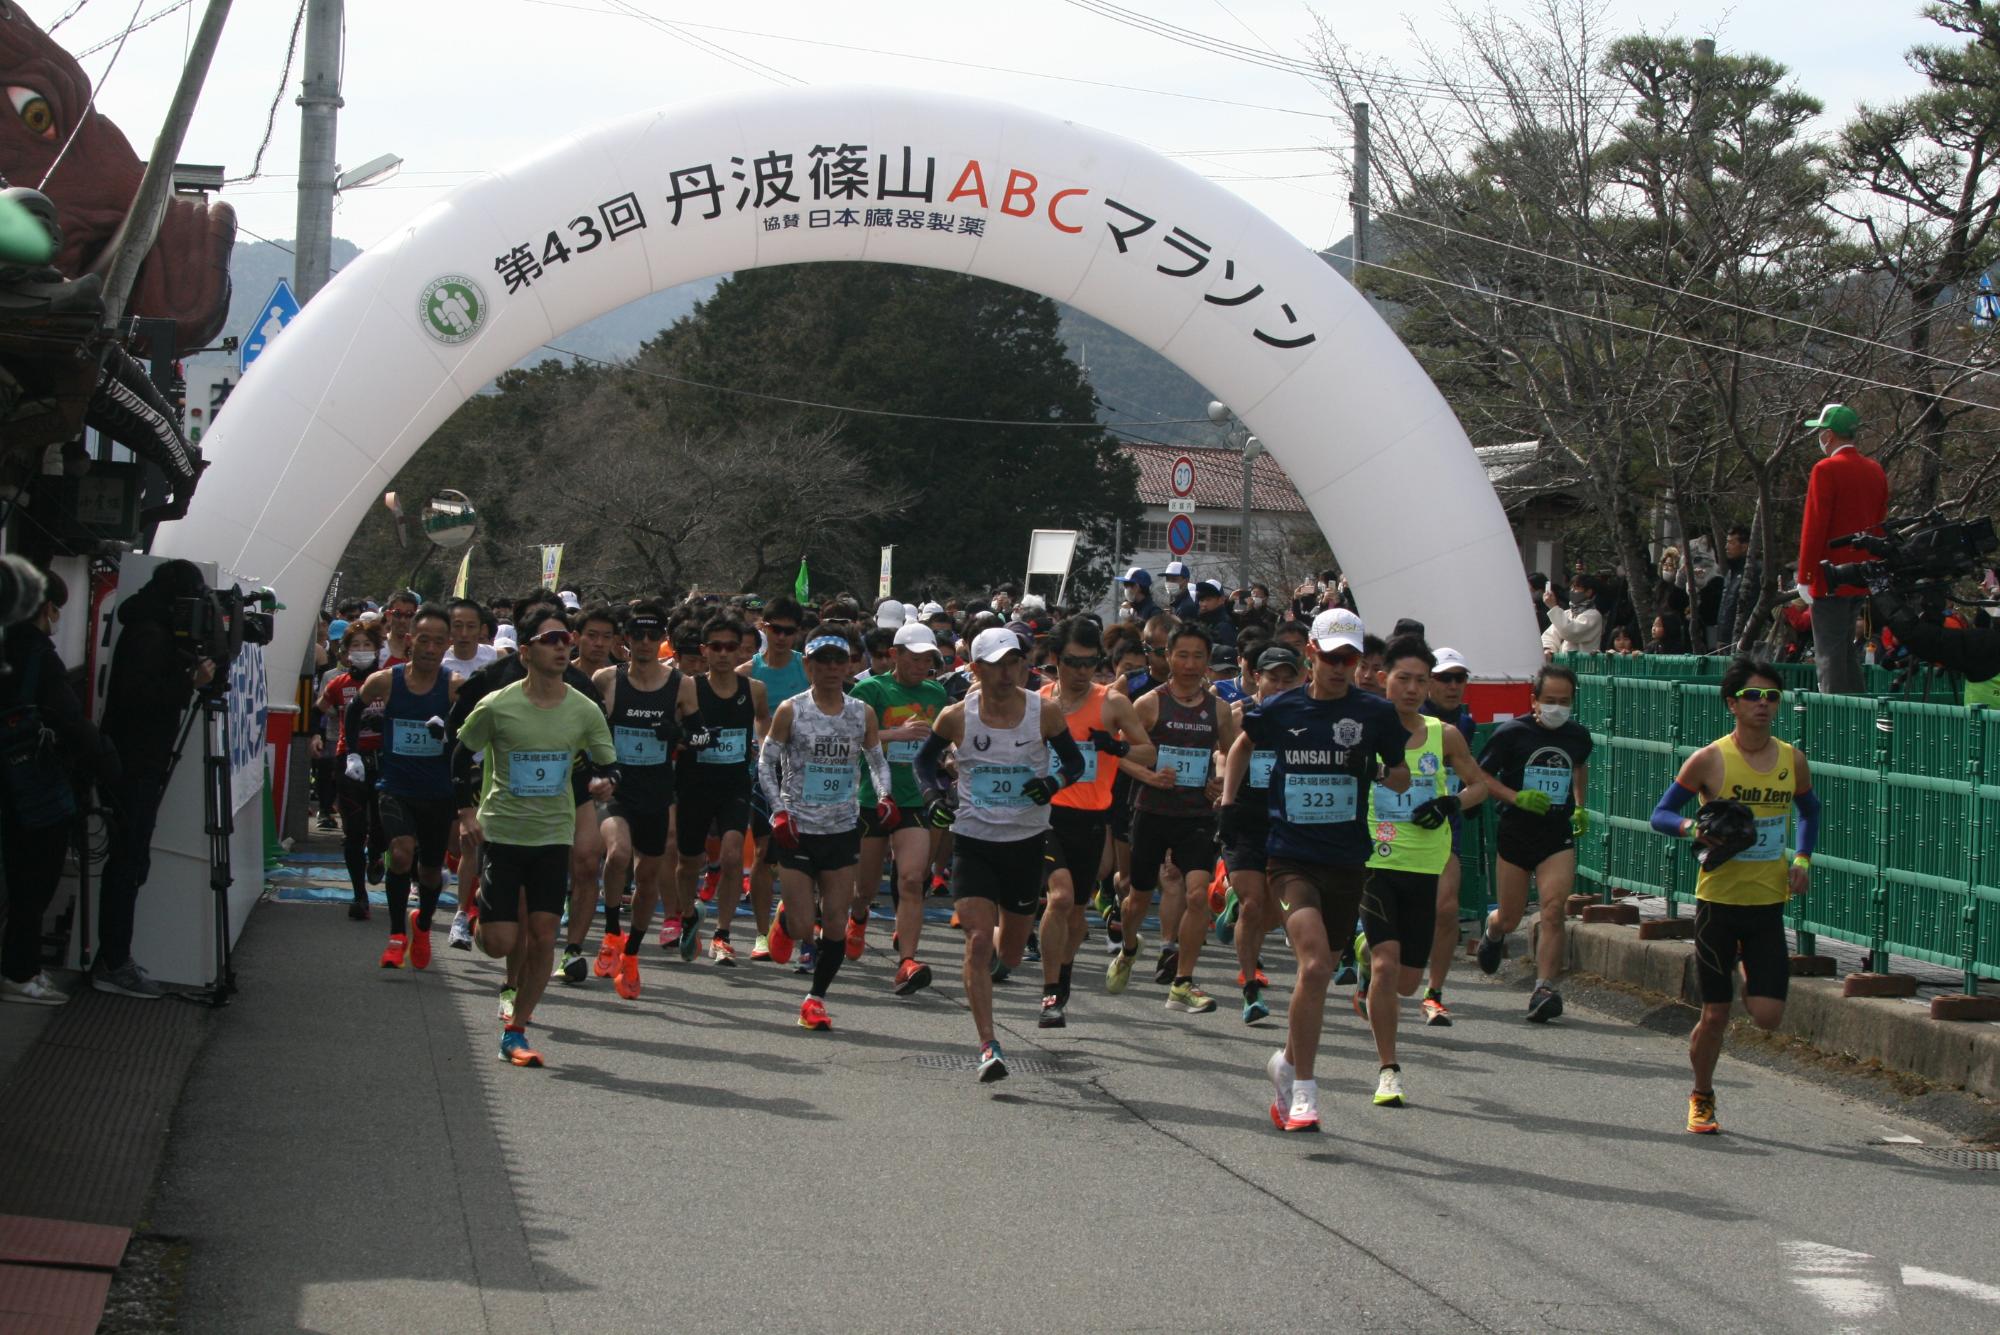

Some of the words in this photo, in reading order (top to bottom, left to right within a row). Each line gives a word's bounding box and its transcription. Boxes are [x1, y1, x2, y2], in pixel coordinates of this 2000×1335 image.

[763, 213, 800, 231] 協賛
[808, 208, 987, 237] 日本臓器製薬
[494, 192, 647, 295] 第43回
[666, 143, 1316, 348] 丹波篠山ABCマラソン
[1177, 468, 1190, 486] 30
[404, 732, 427, 745] 321
[635, 742, 643, 753] 4
[814, 743, 850, 757] RUN
[1285, 749, 1331, 765] KANSAI
[536, 767, 545, 781] 9
[1176, 761, 1190, 773] 31
[823, 779, 840, 791] 98
[992, 780, 1011, 793] 20
[1537, 780, 1559, 792] 119
[1302, 792, 1334, 807] 323
[1732, 784, 1761, 802] Sub
[1763, 788, 1791, 803] Zero
